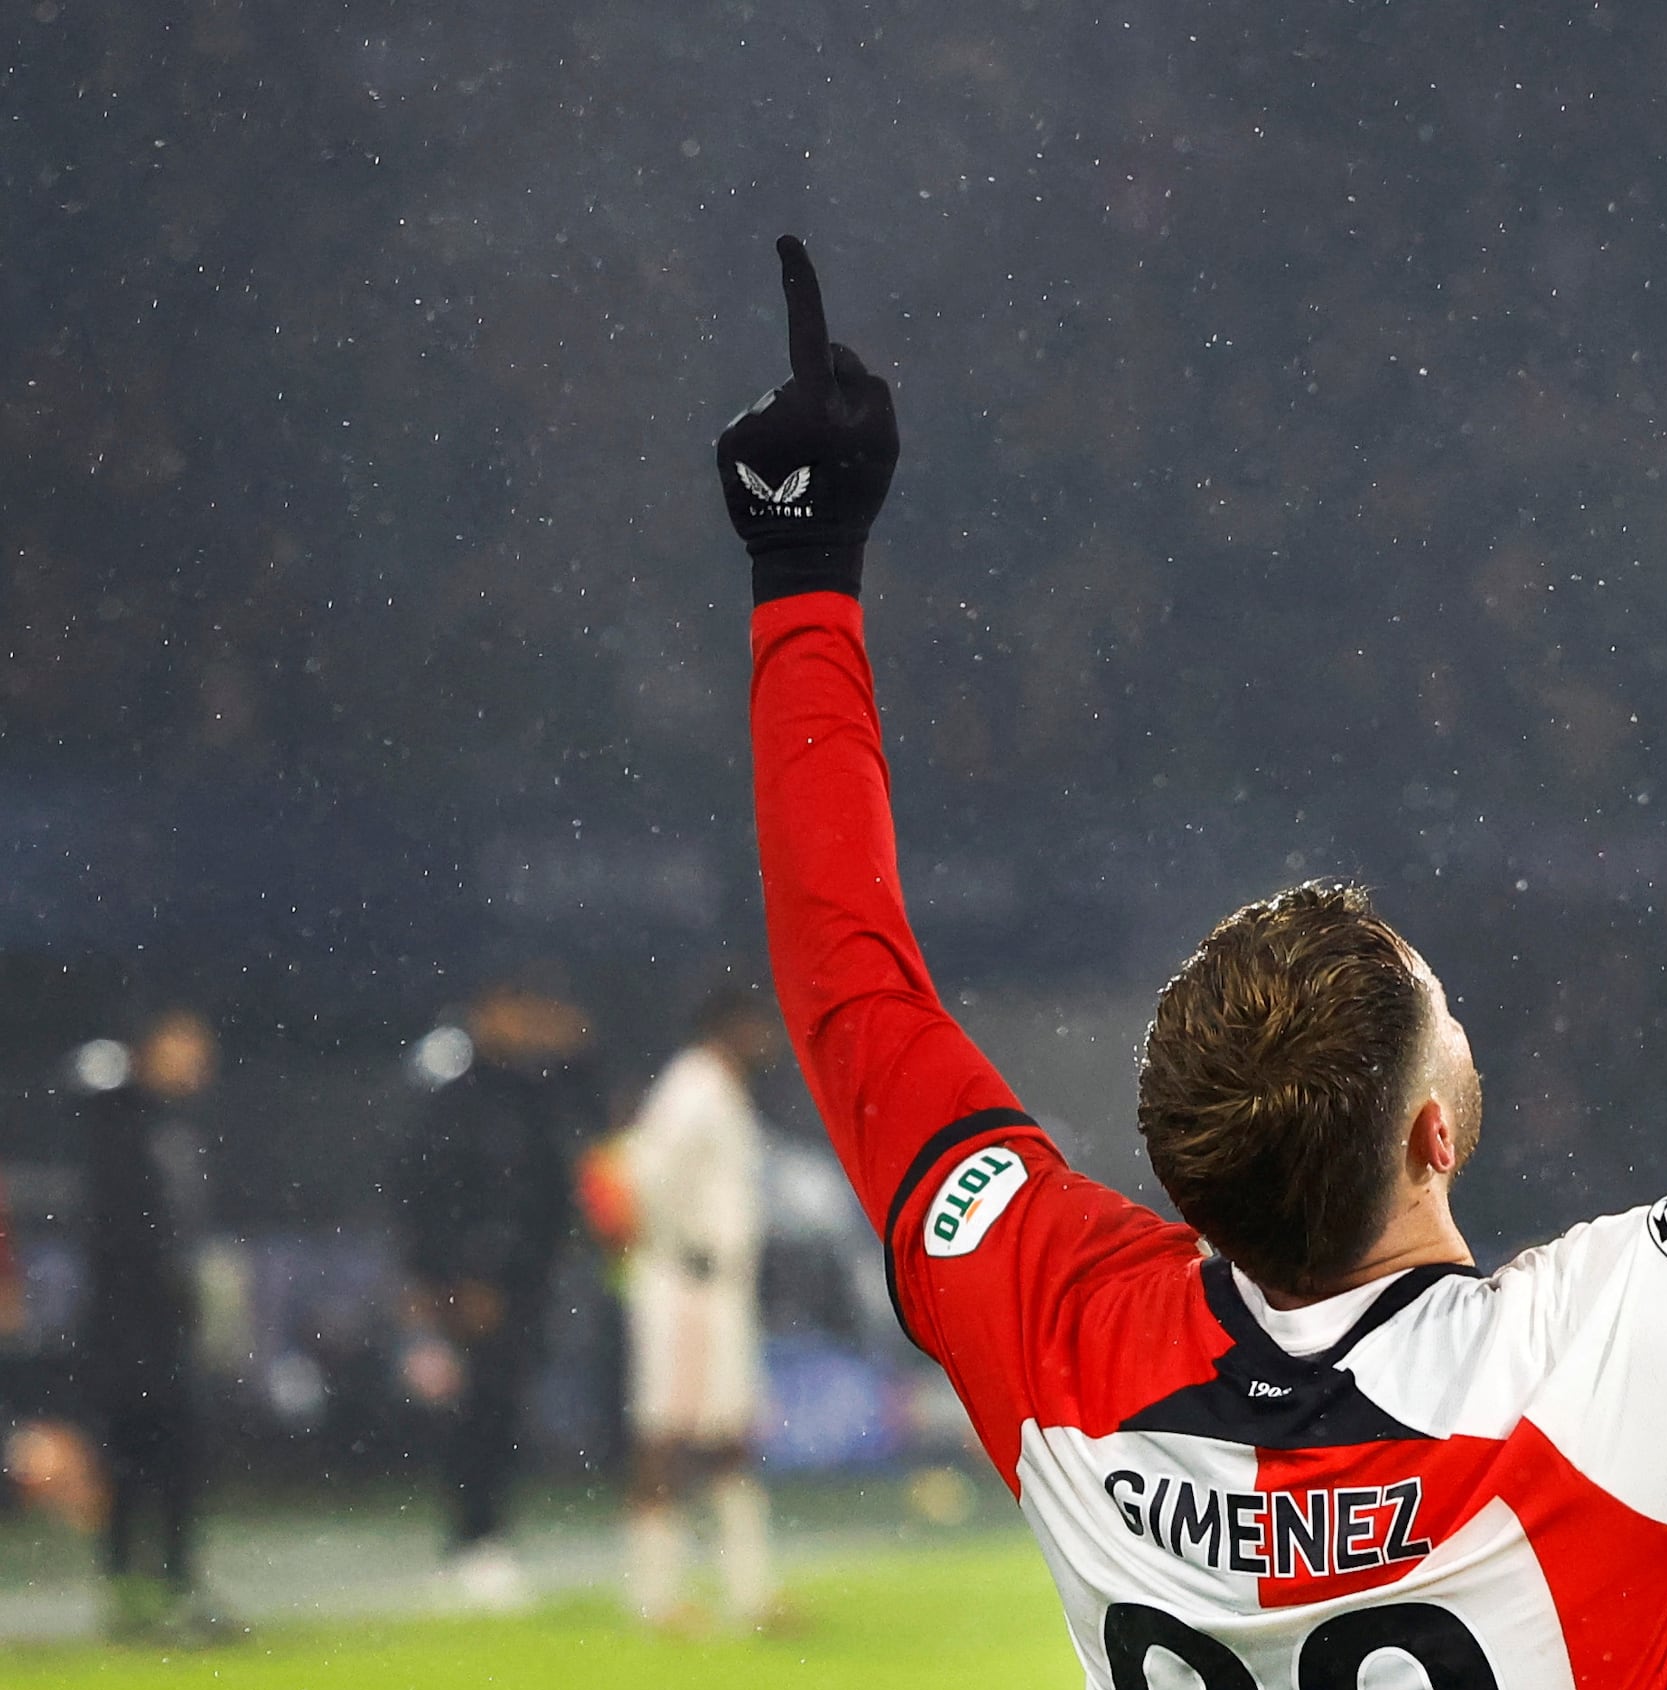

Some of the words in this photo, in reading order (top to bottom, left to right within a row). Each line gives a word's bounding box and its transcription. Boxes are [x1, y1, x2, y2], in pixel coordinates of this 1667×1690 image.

[934, 1156, 1013, 1242] TOTO
[1248, 1380, 1292, 1397] 190
[1103, 1468, 1432, 1578] GIMENEZ
